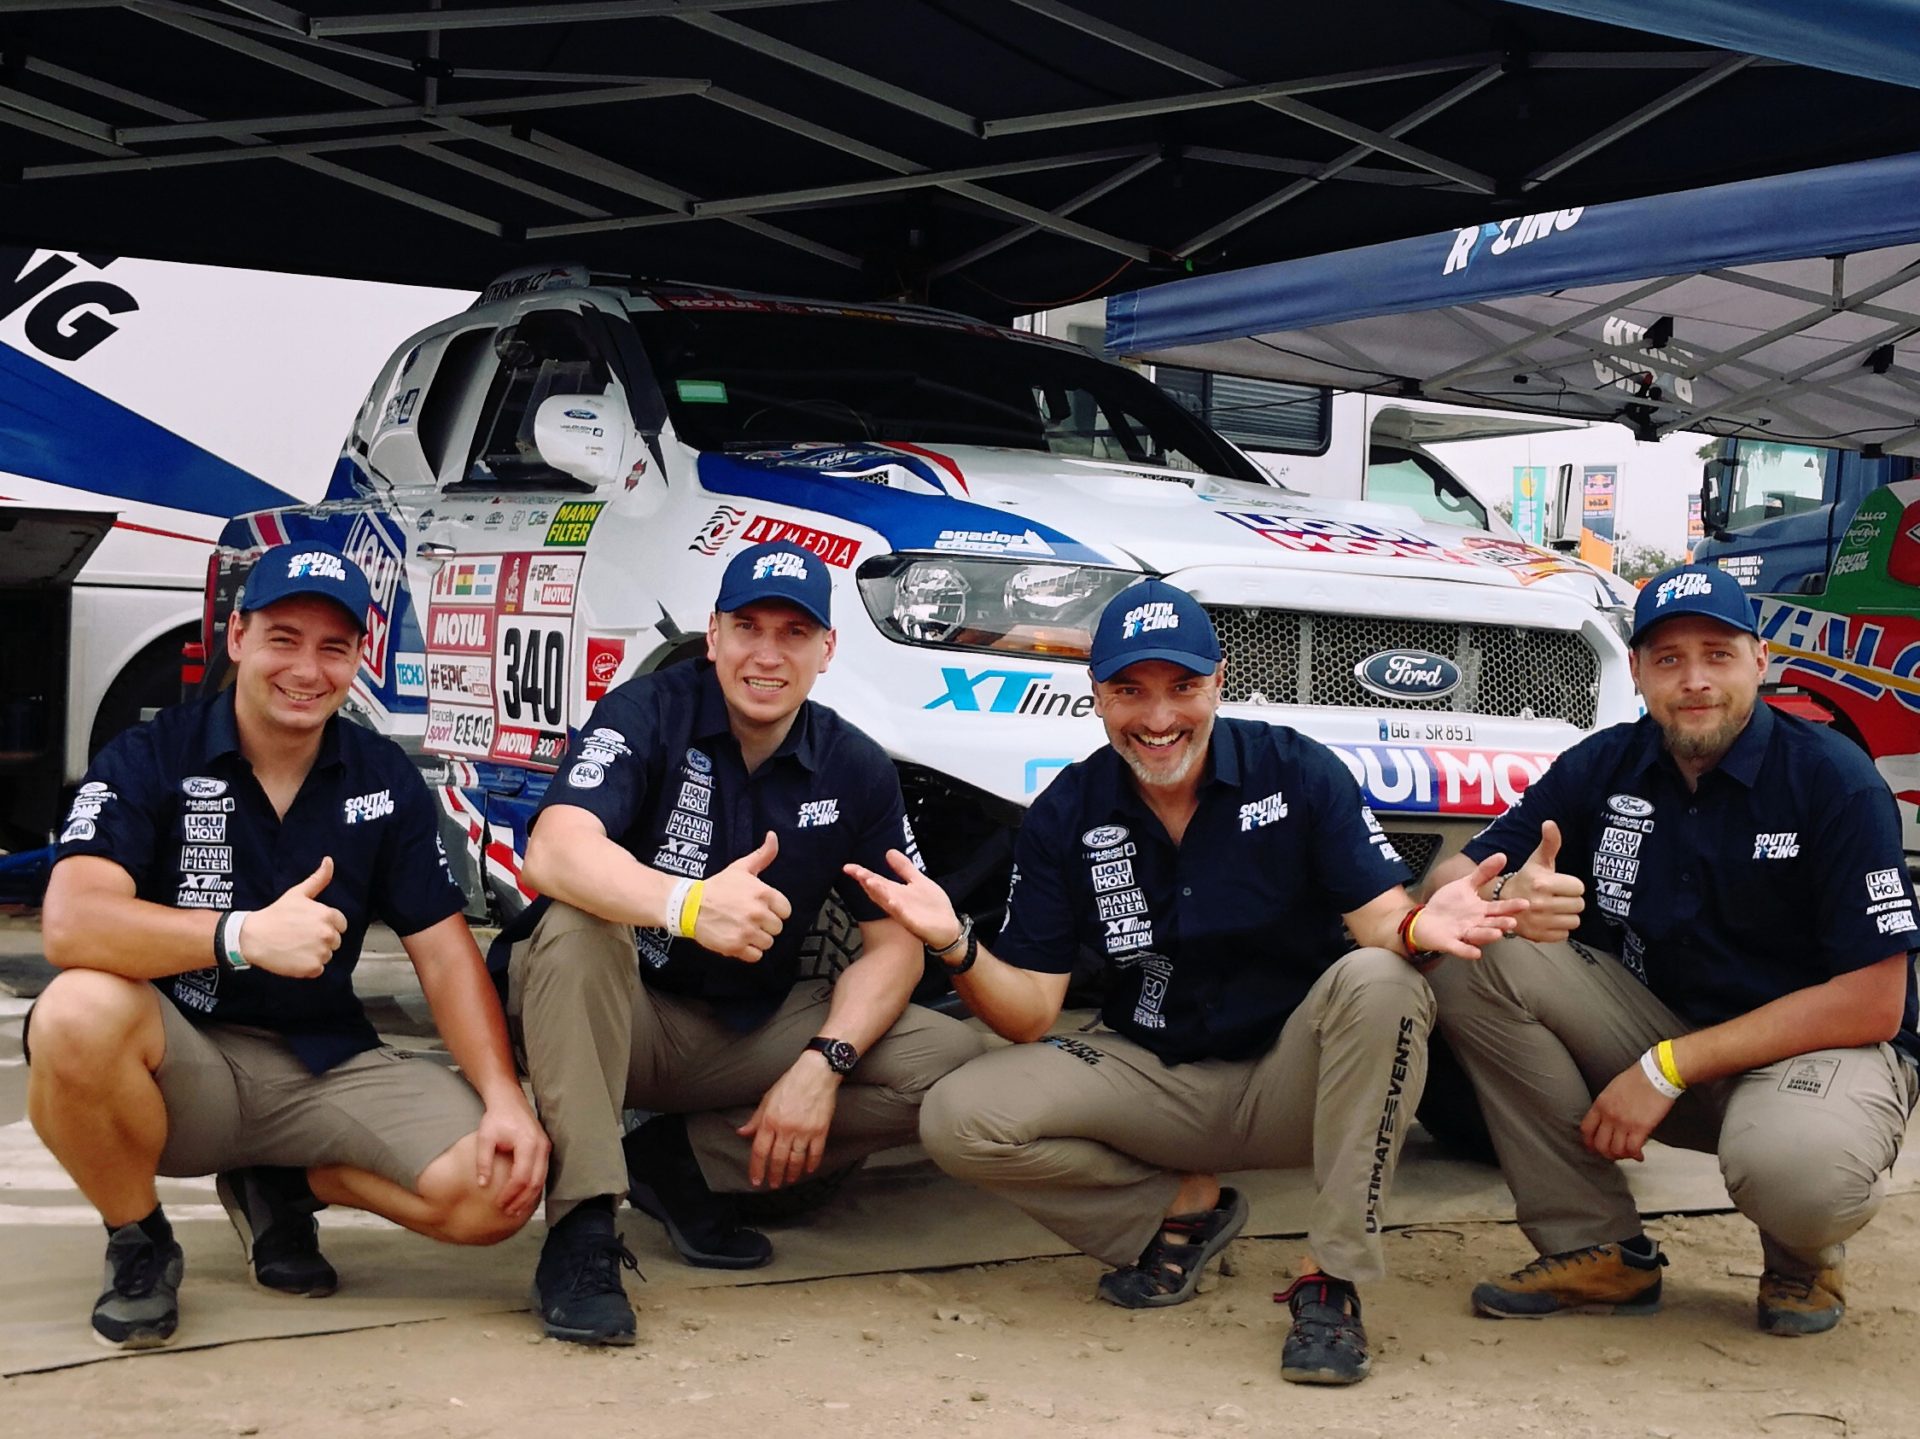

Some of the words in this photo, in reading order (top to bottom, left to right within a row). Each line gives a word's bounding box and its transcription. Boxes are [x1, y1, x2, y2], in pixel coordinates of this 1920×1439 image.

[555, 504, 599, 523] MANN
[546, 523, 590, 543] FILTER
[1227, 511, 1438, 549] LIQUI
[289, 551, 343, 569] SOUTH
[754, 551, 806, 569] SOUTH
[1838, 551, 1869, 563] SOUTH
[1658, 573, 1708, 594] SOUTH
[543, 586, 573, 602] MOTUL
[1124, 602, 1174, 624] SOUTH
[433, 613, 486, 646] MOTUL
[503, 627, 565, 726] 340
[1384, 655, 1442, 687] Ford
[923, 667, 1094, 718] XTline
[1391, 722, 1410, 739] GG
[497, 732, 533, 755] MOTUL
[189, 780, 218, 794] Ford
[1436, 750, 1555, 806] MO
[345, 789, 390, 812] SOUTH
[684, 785, 709, 801] LIQUI
[680, 795, 708, 812] MOLY
[799, 798, 838, 816] SOUTH
[1239, 791, 1282, 819] SOUTH
[1616, 797, 1646, 813] Ford
[188, 816, 223, 827] LIQUI
[672, 813, 710, 833] MANN
[189, 828, 223, 840] MOLY
[669, 823, 709, 843] FILTER
[1091, 829, 1119, 845] Ford
[1606, 829, 1639, 844] LIQUI
[1754, 832, 1798, 847] SOUTH
[185, 847, 229, 860] MANN
[1602, 841, 1636, 856] MOLY
[184, 859, 229, 870] FILTER
[655, 851, 707, 873] HONITON
[1094, 862, 1129, 878] LIQUI
[1596, 855, 1636, 871] MANN
[1096, 872, 1131, 890] MOLY
[1595, 865, 1633, 881] FILTER
[177, 890, 233, 904] HONITON
[1100, 890, 1142, 908] MANN
[1102, 901, 1144, 918] FILTER
[1106, 930, 1153, 948] HONITON
